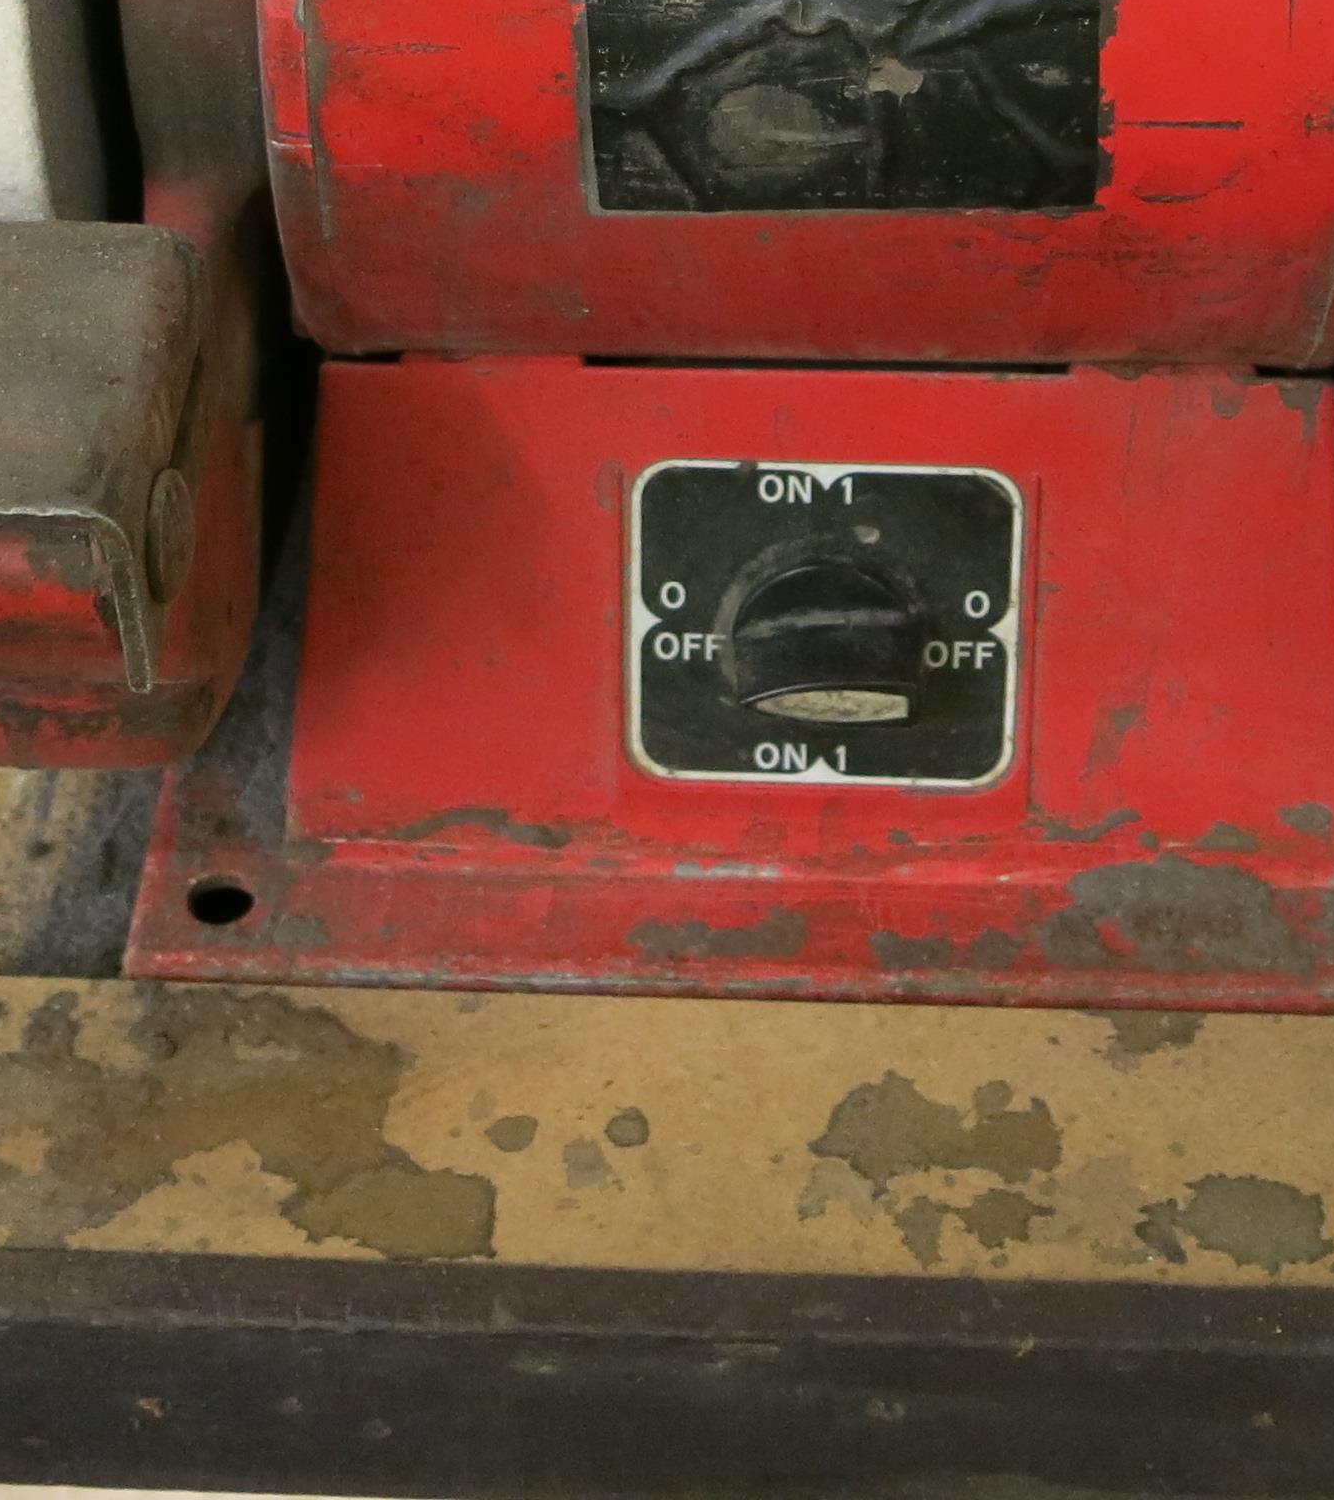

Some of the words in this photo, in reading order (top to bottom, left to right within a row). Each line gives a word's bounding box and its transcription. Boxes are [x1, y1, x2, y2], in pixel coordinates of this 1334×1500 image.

[758, 474, 812, 505] ON
[840, 478, 854, 505] 1
[654, 632, 727, 662] OFF
[925, 640, 997, 670] OFF
[754, 742, 808, 769] ON
[835, 744, 848, 771] 1
